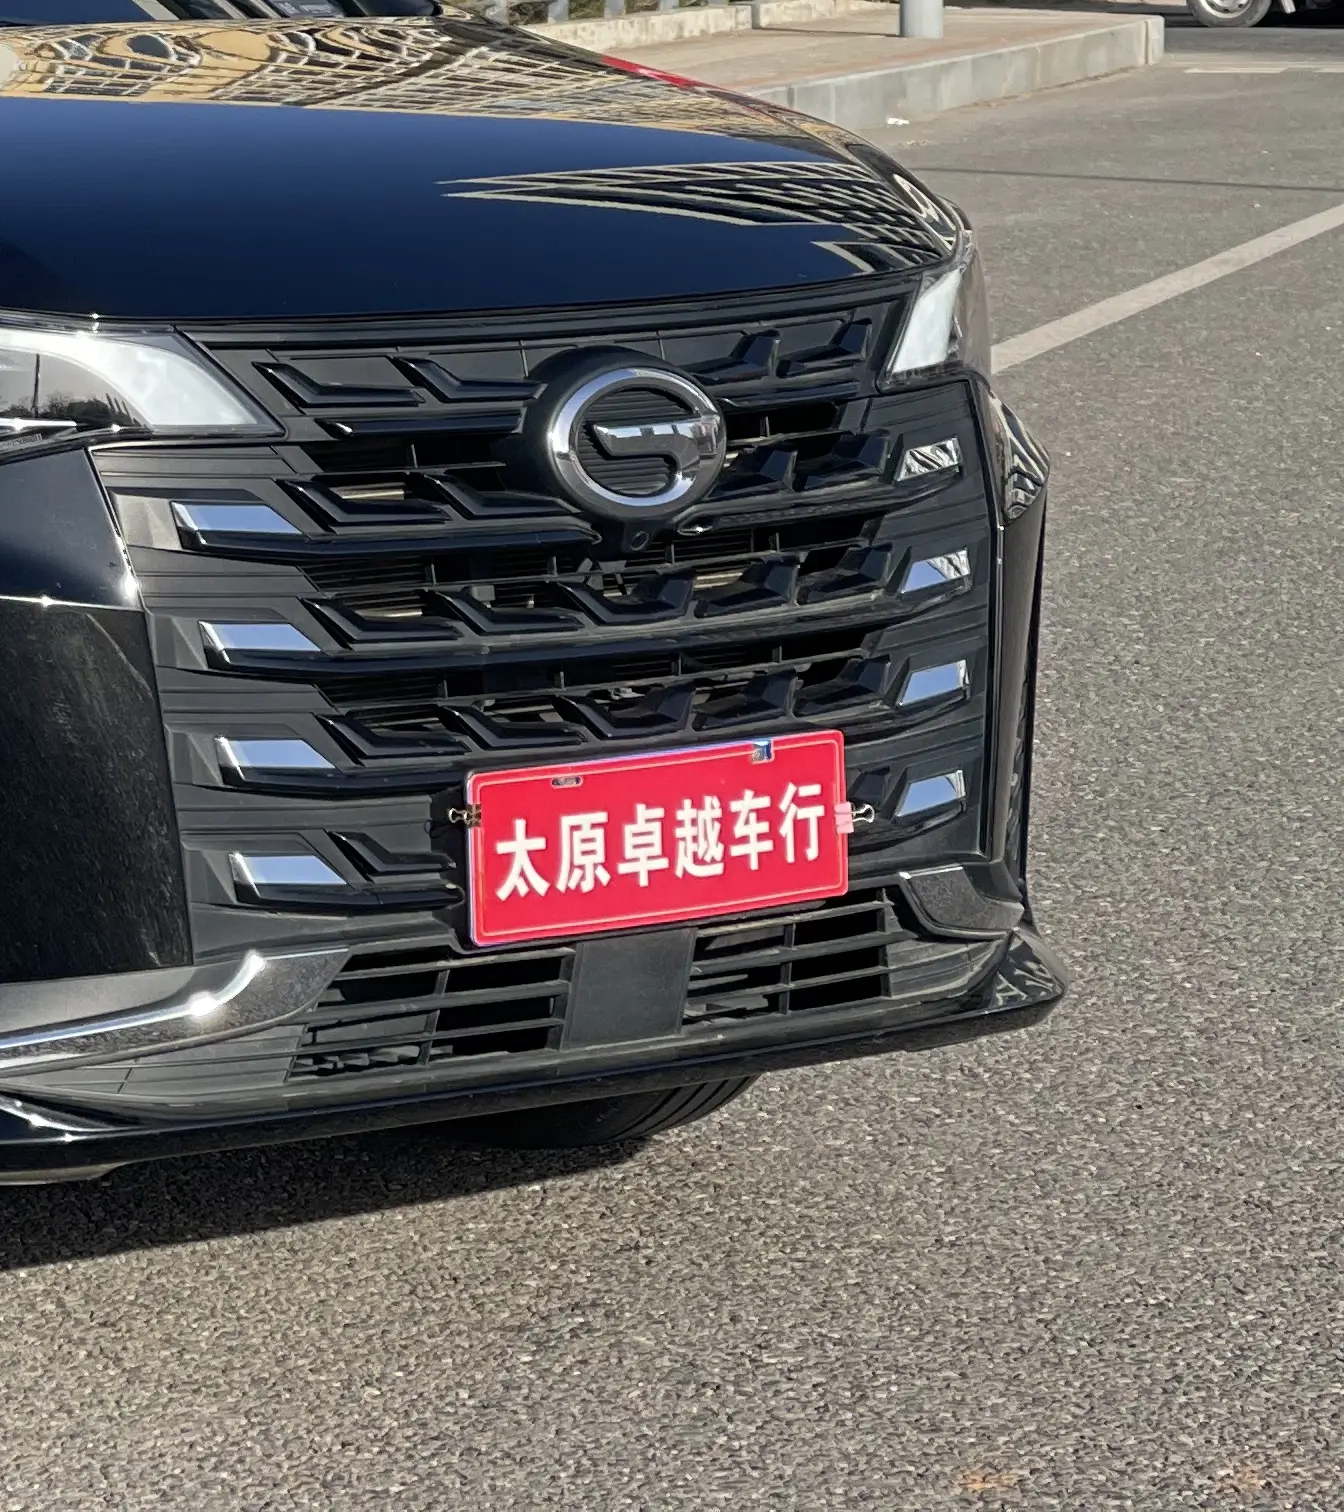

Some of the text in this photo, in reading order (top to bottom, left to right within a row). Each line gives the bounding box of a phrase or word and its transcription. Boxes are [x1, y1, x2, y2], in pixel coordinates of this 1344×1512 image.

[495, 782, 826, 901] 太原卓越车行
